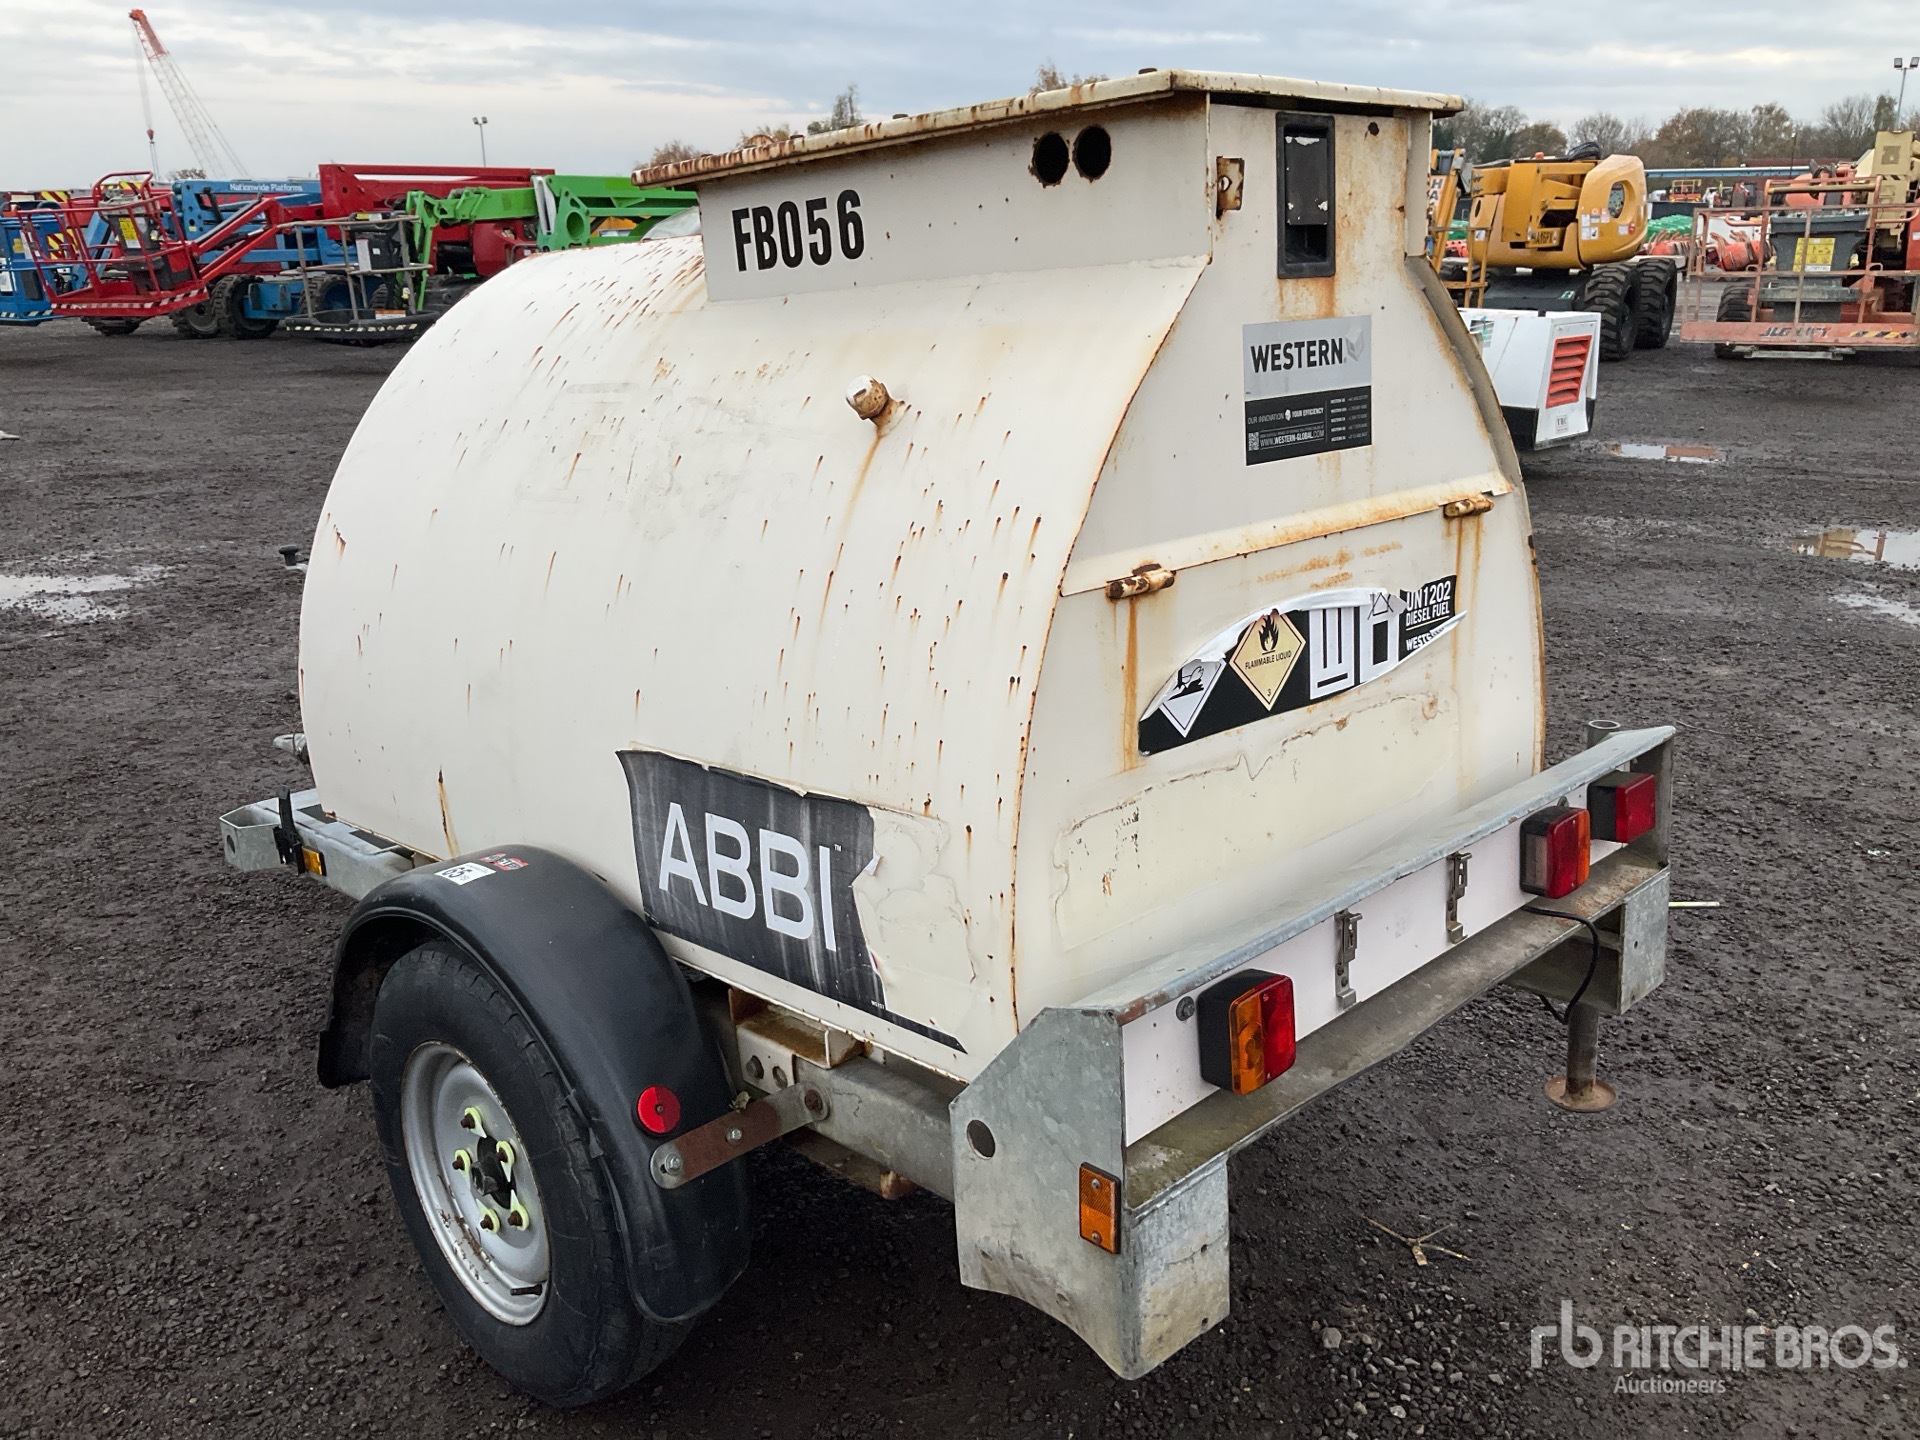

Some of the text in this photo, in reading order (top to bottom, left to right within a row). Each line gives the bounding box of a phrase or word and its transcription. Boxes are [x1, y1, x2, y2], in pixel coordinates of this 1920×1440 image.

[229, 183, 303, 192] Nationwide Platforms
[732, 189, 865, 272] FB056
[1250, 337, 1343, 374] WESTERN
[1247, 416, 1258, 425] OUR
[1258, 412, 1284, 423] INNOVATION
[1292, 409, 1303, 418] YOUR
[1260, 430, 1325, 447] WWW.WESTERN-GLOBAL.COM
[1406, 580, 1451, 611] UN1202
[1406, 601, 1450, 626] DIESEL FUEL
[1245, 650, 1292, 669] FLAMMABLE LIQUID
[1266, 688, 1272, 697] 3
[659, 802, 837, 952] ABBI
